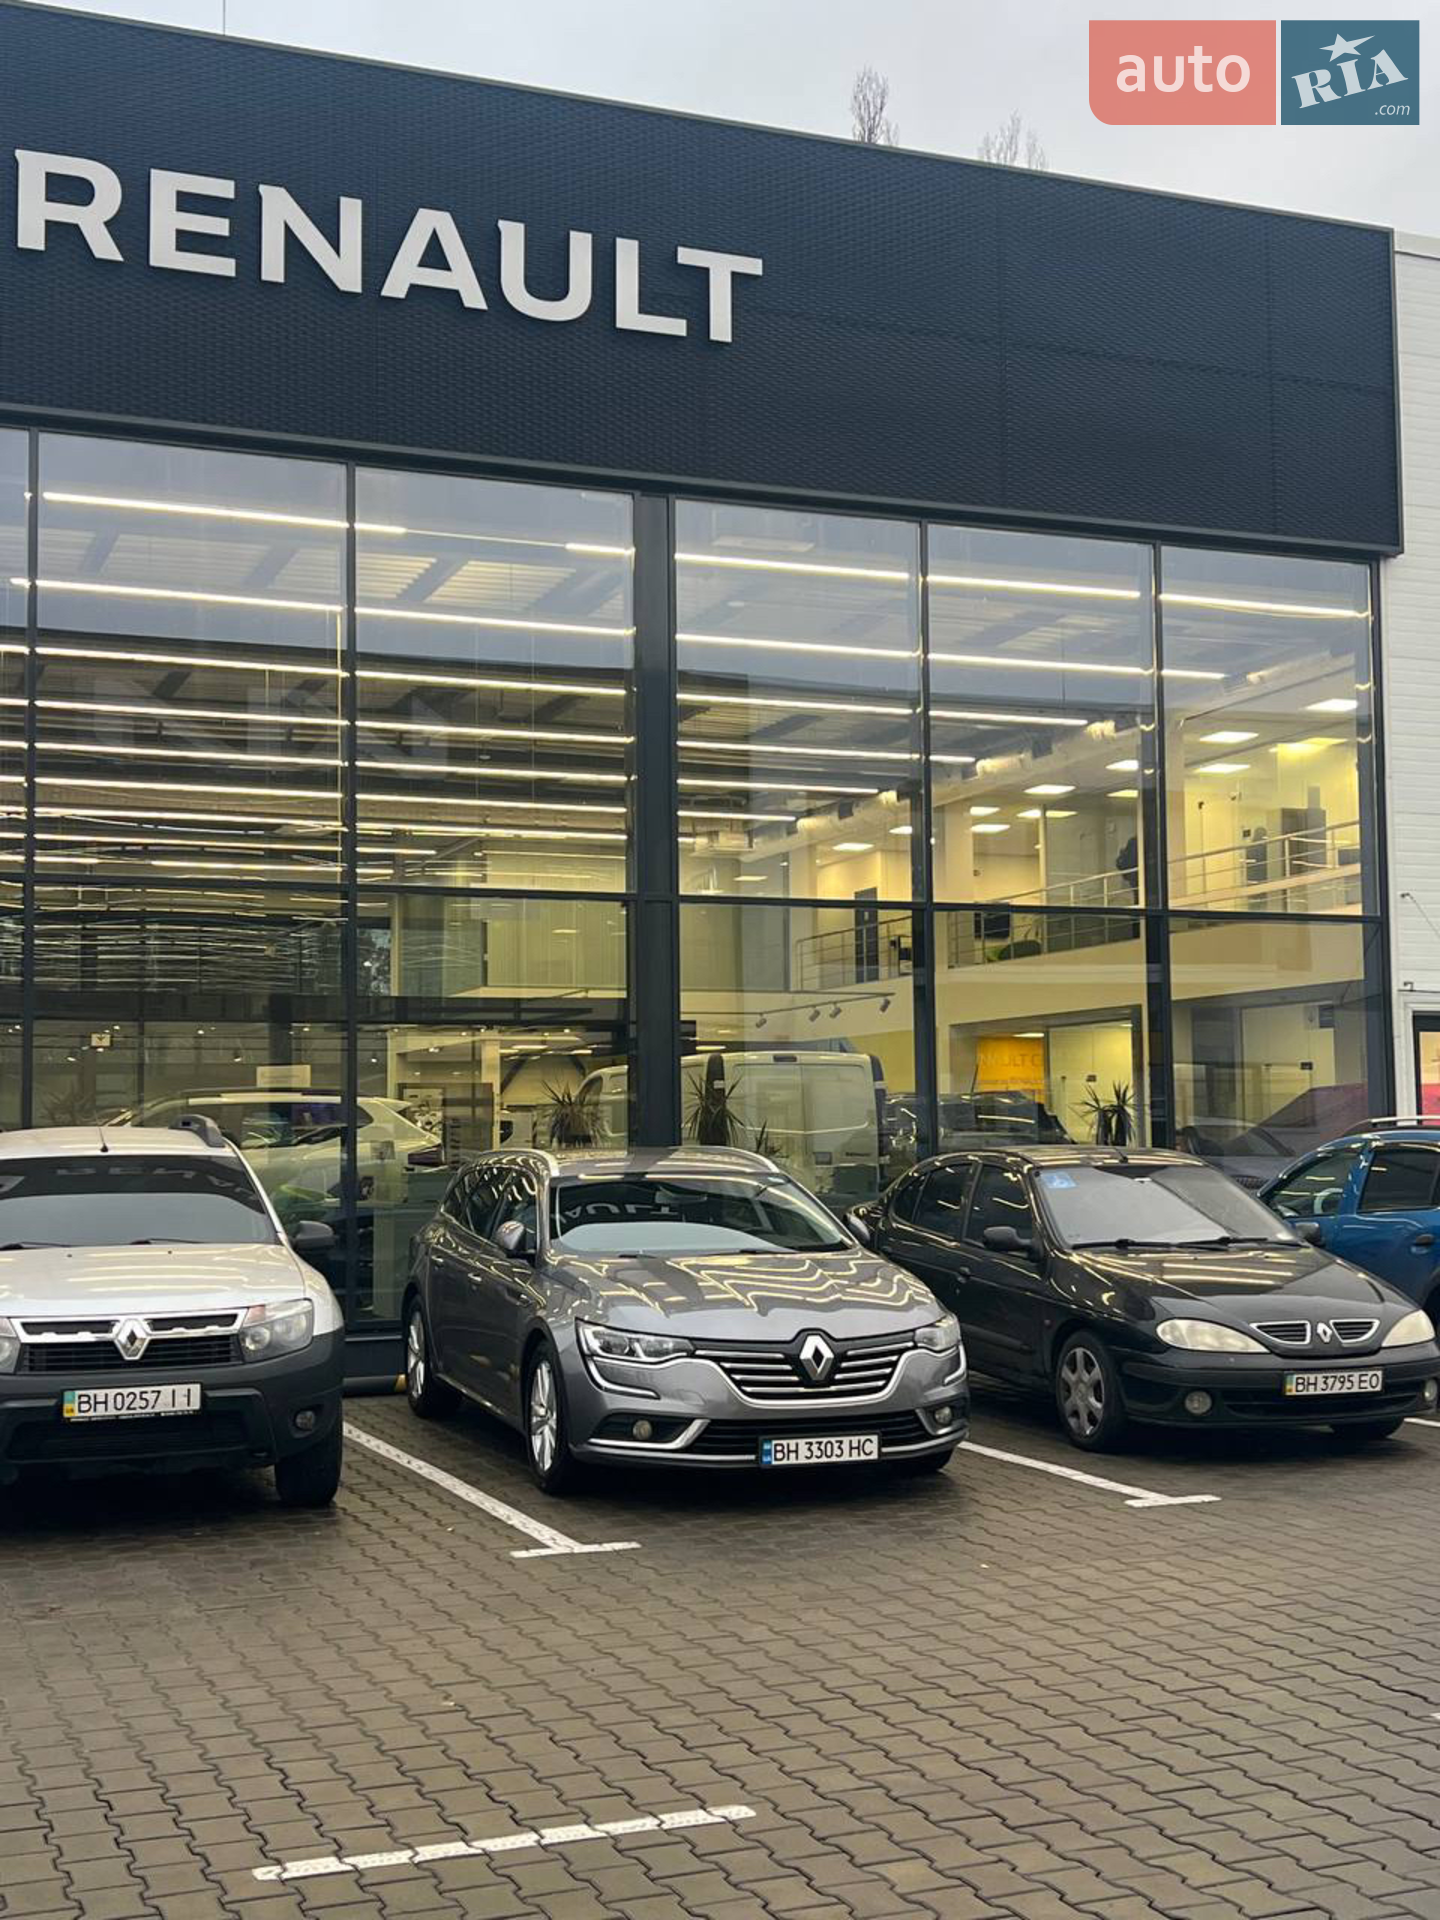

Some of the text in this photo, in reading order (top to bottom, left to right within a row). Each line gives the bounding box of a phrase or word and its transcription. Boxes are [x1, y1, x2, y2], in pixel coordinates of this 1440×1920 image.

[14, 148, 763, 343] RENAULT
[1295, 1373, 1380, 1393] BH 3795 EO
[77, 1392, 108, 1413] BH
[113, 1390, 162, 1411] 0257
[773, 1438, 874, 1462] BH 3303 HC
